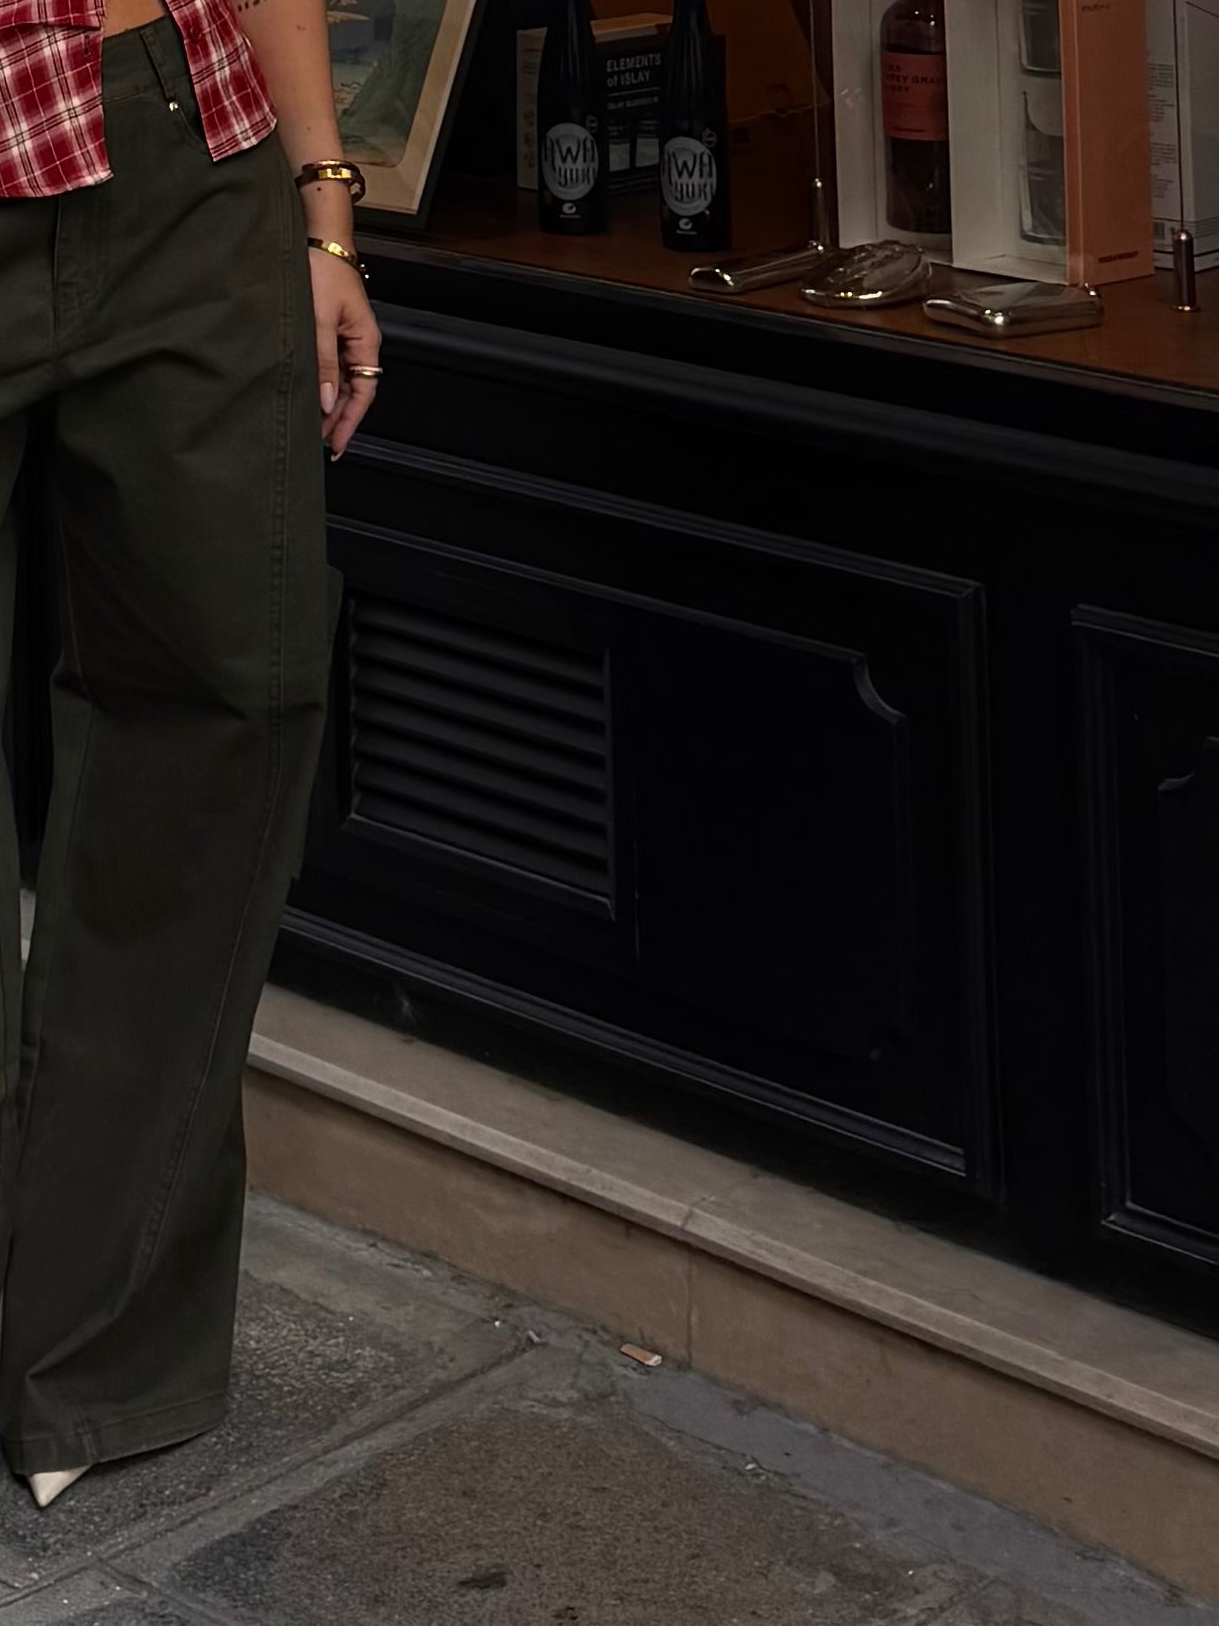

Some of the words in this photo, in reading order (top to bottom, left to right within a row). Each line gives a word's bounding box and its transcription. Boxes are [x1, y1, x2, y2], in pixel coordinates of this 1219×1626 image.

[606, 53, 662, 72] ELEMENTS
[606, 74, 618, 87] of
[620, 69, 650, 86] ISLAY
